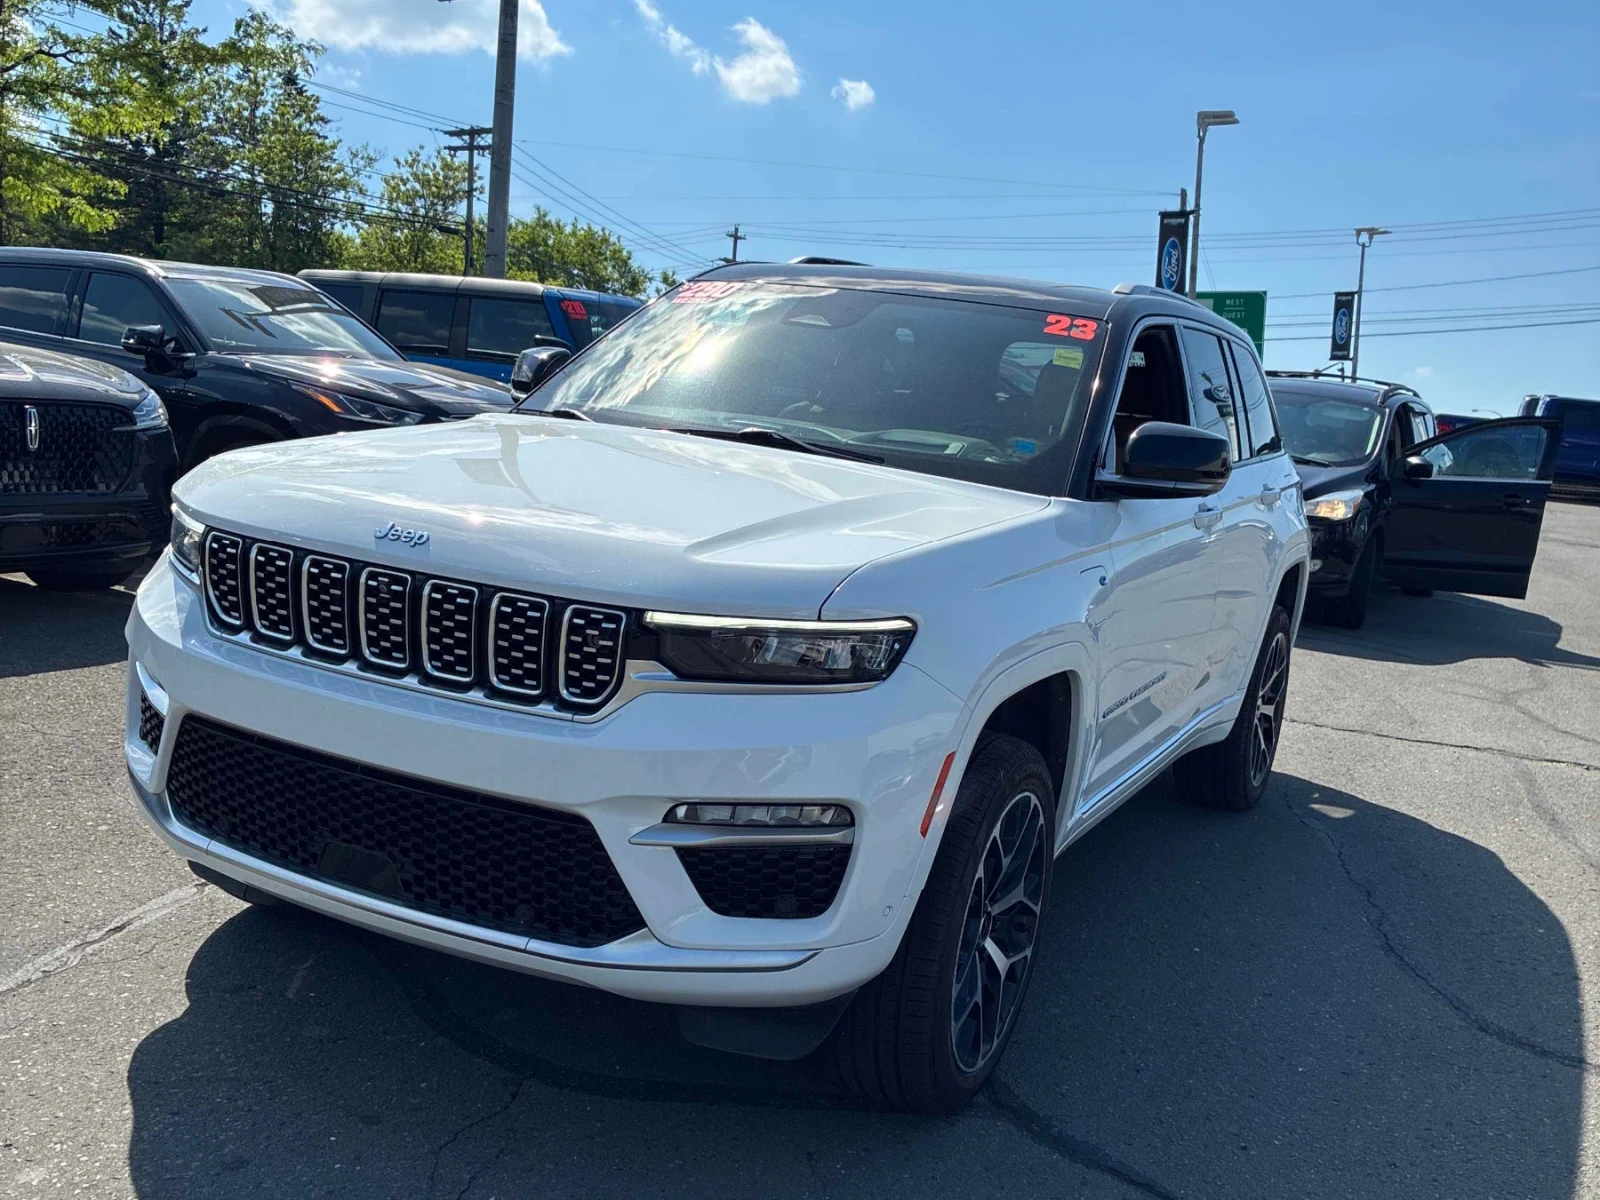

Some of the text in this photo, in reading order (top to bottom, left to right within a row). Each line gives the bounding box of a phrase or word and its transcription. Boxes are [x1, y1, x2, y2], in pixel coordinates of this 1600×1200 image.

[1164, 247, 1179, 282] Ford
[1043, 314, 1099, 341] 23
[374, 521, 430, 548] Jeep
